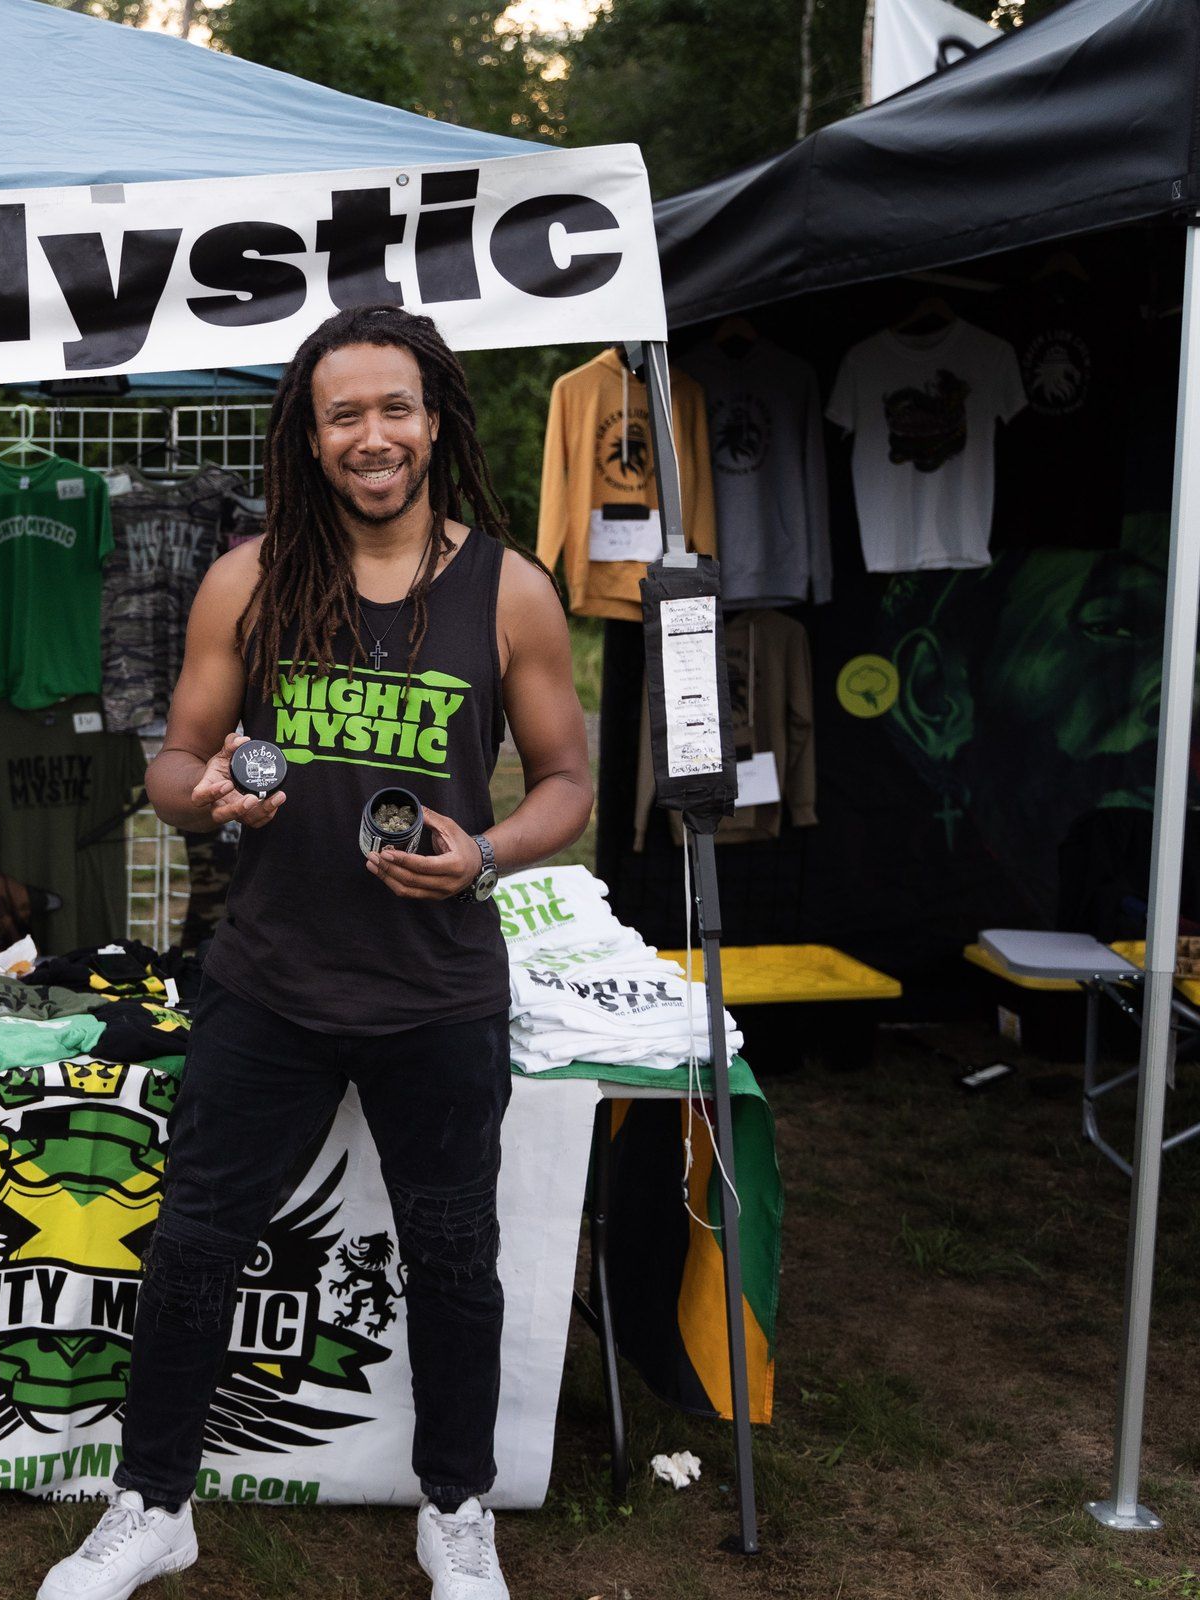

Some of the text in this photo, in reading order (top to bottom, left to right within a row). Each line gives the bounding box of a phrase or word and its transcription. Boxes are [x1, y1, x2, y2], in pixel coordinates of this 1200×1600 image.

[126, 519, 205, 548] MIGHTY
[273, 673, 465, 728] MIGHTY
[275, 708, 450, 764] MYSTIC
[6, 754, 93, 780] MIGHTY
[239, 745, 278, 764] Lisbon
[8, 778, 92, 805] MYSTIC
[499, 898, 575, 938] STIC
[632, 1001, 685, 1014] REGGAE MUSIC
